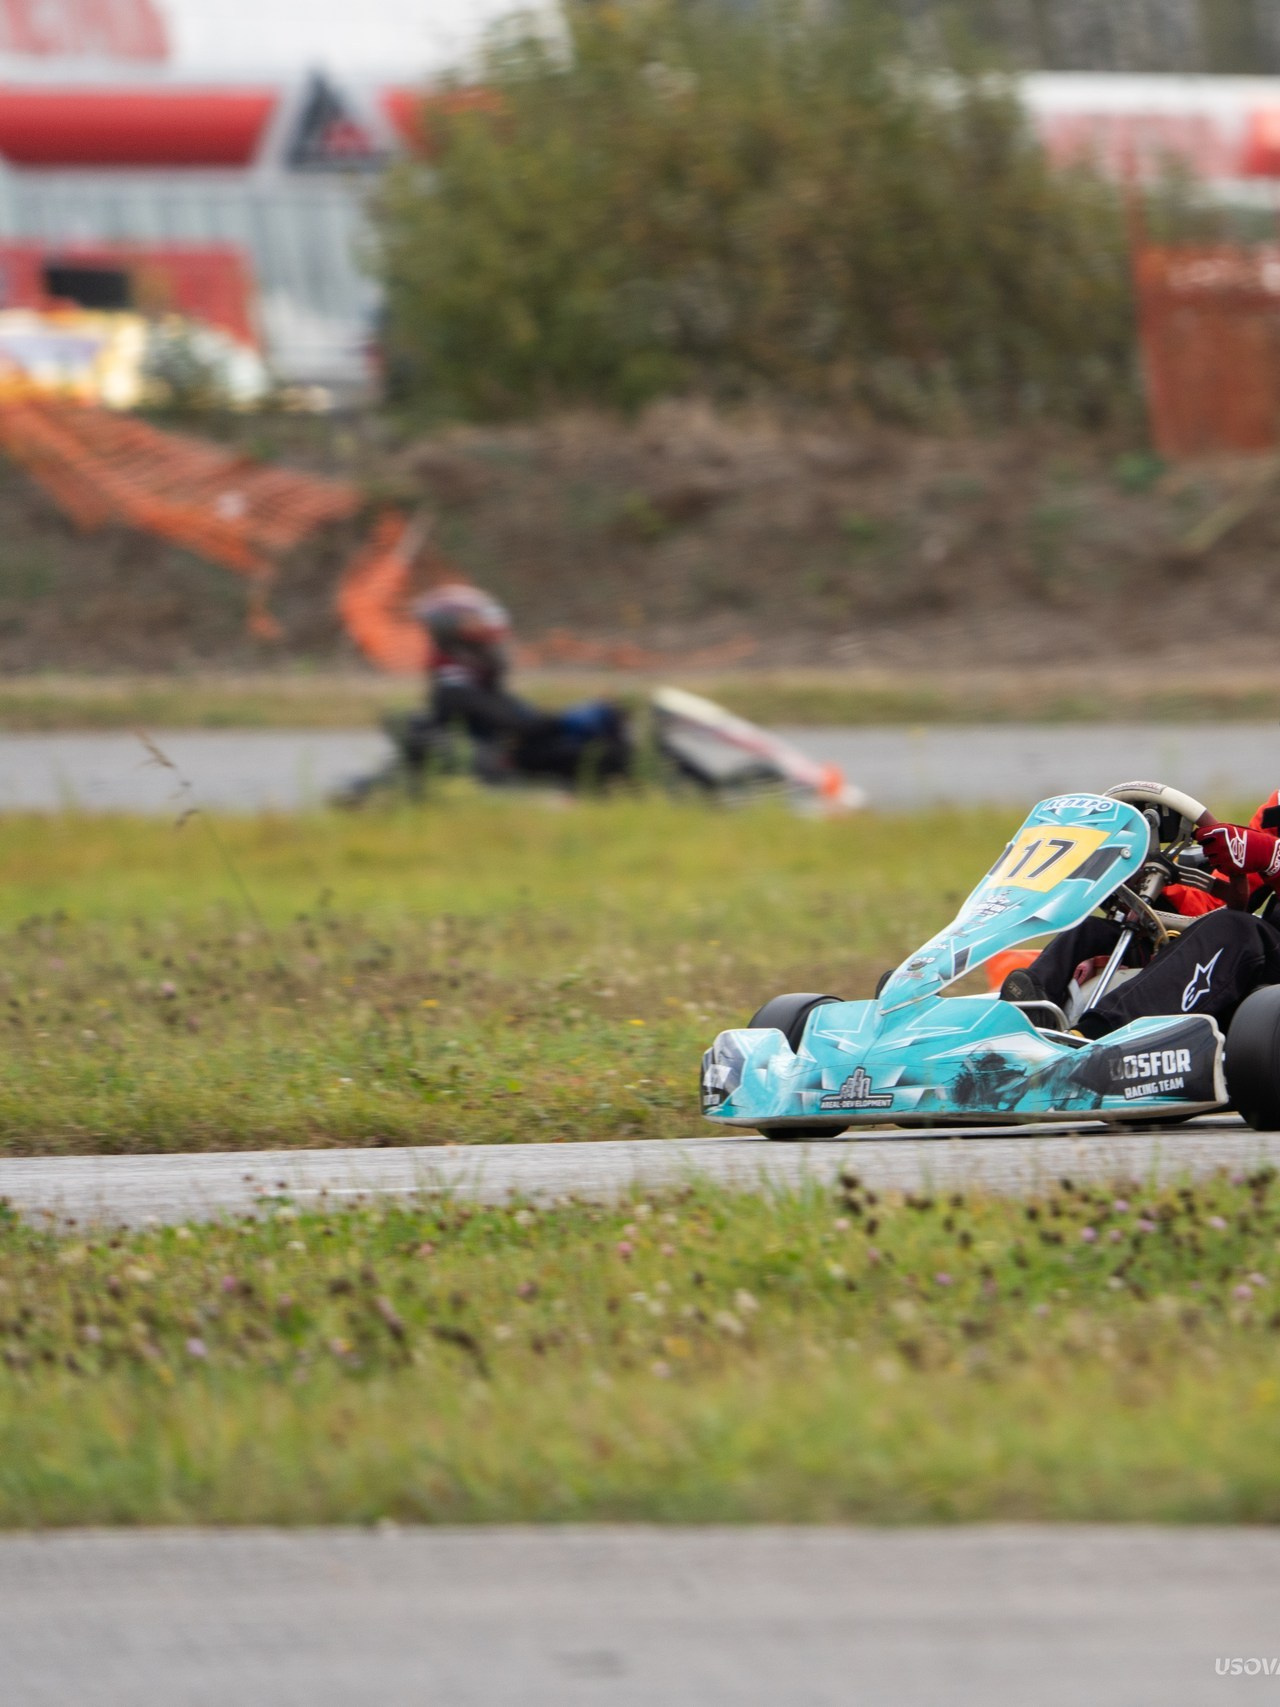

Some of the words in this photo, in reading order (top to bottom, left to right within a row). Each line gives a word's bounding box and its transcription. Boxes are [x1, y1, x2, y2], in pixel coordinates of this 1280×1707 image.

[1004, 837, 1078, 880] 17
[1124, 1082, 1159, 1099] RACING
[1159, 1077, 1185, 1093] TEAM
